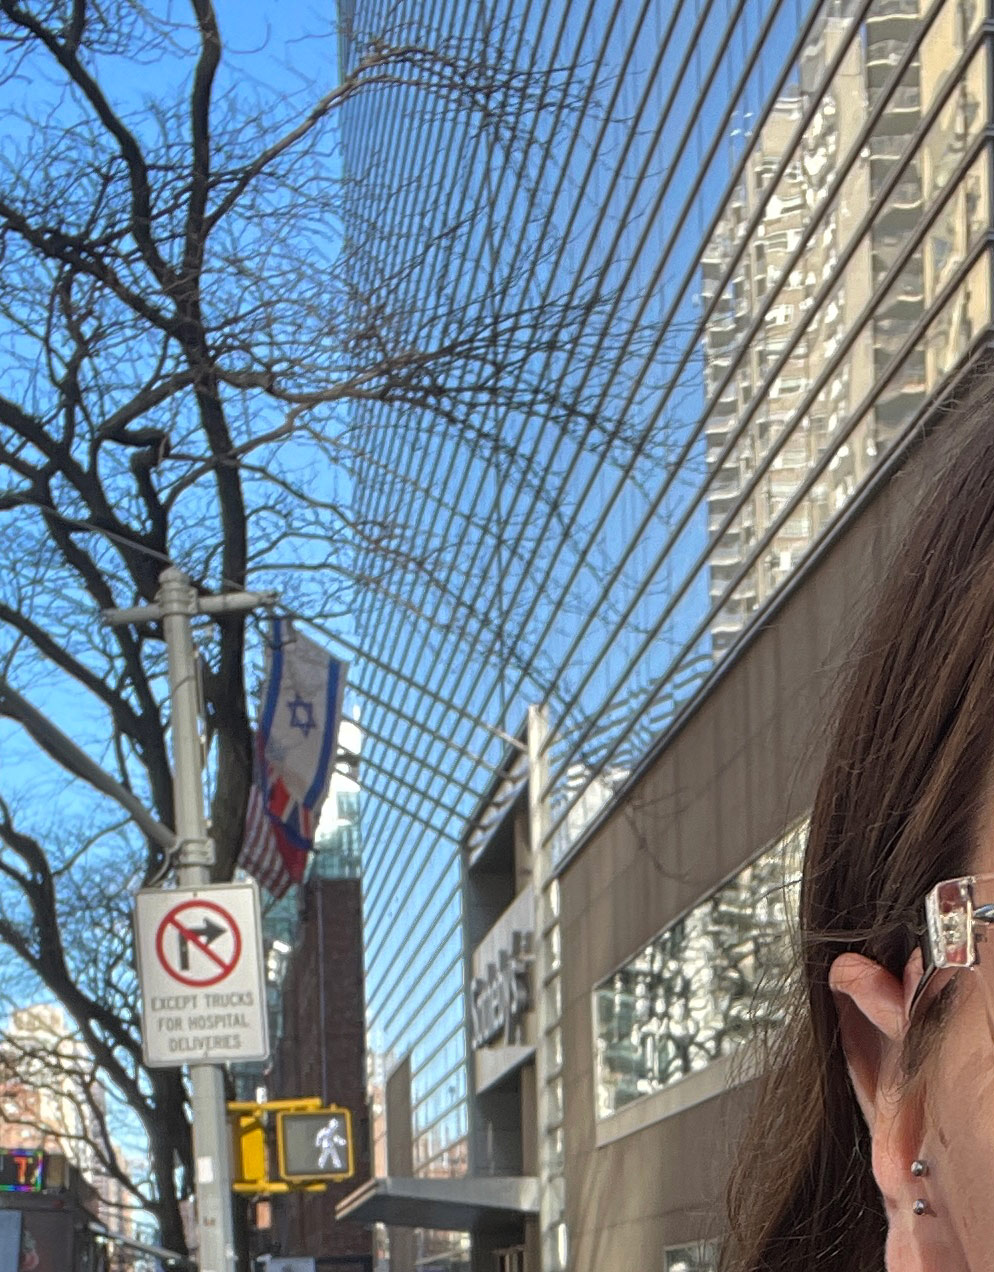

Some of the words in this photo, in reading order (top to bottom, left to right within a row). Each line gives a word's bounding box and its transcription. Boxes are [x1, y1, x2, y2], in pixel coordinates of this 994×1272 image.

[151, 994, 198, 1012] EXCEPT
[205, 991, 254, 1009] TRUCKS
[158, 1017, 183, 1032] FOR
[188, 1013, 249, 1031] HOSPITAL
[169, 1034, 242, 1053] DELIVERIES
